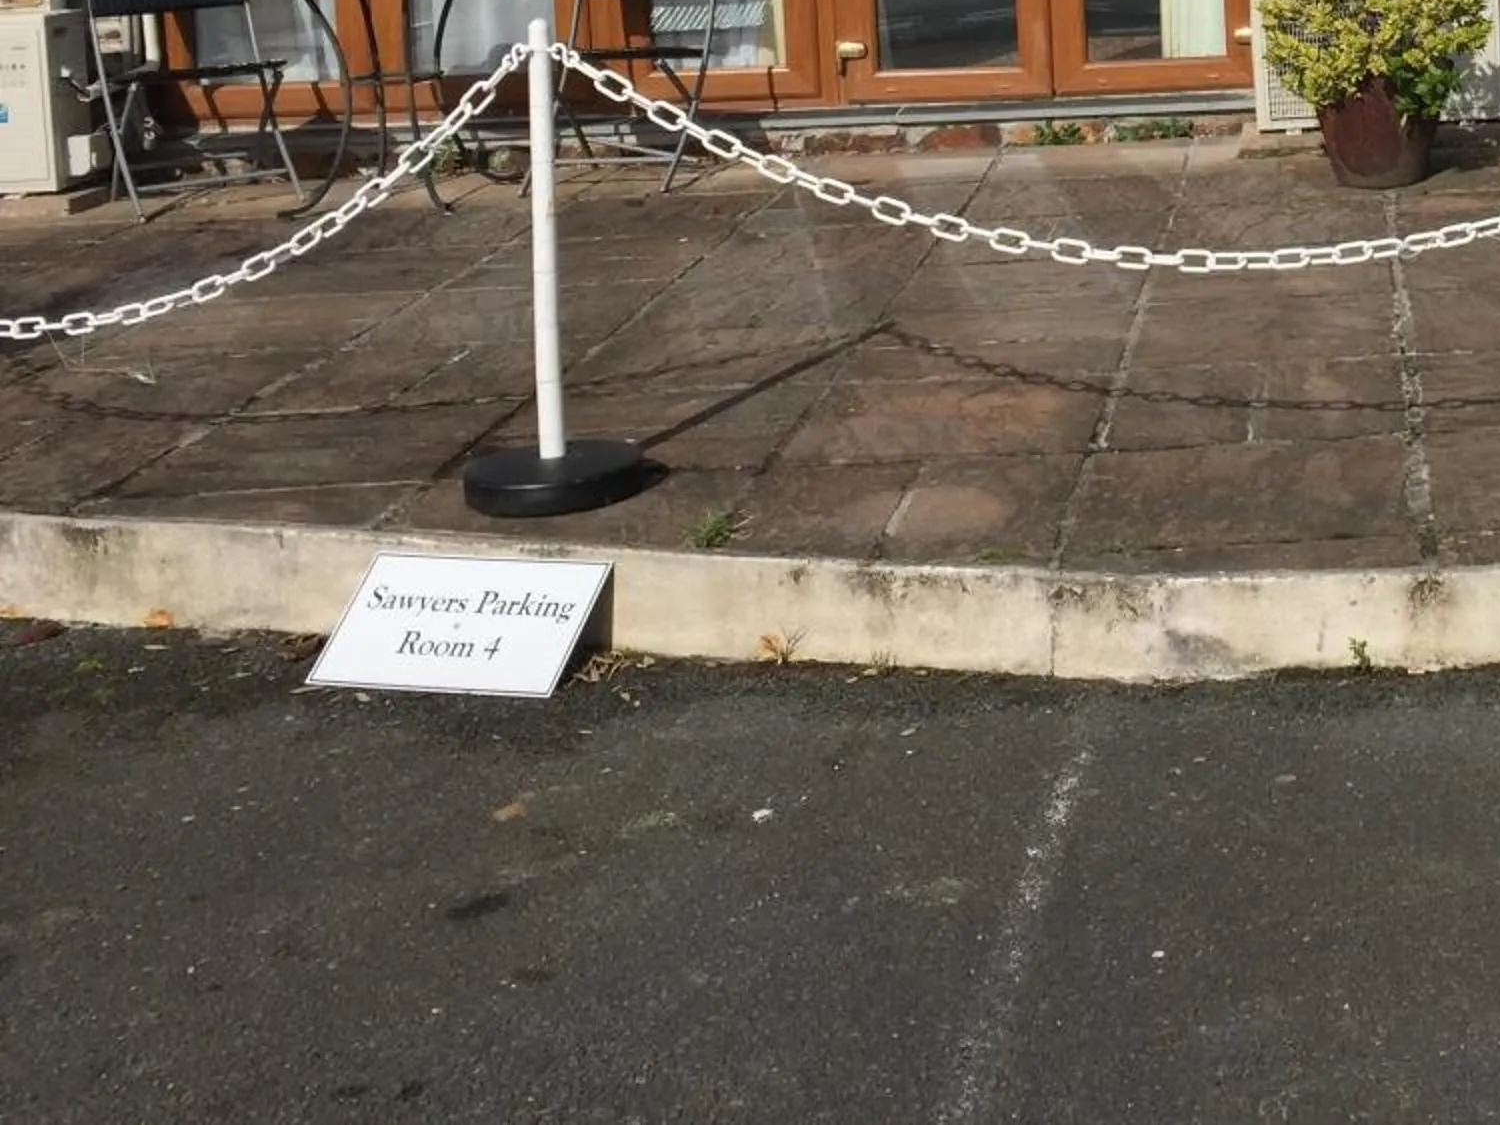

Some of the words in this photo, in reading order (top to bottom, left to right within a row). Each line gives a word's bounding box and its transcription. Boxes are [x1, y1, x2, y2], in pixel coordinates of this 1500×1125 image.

[366, 584, 468, 617] Sawyers
[472, 589, 577, 625] Parking
[395, 630, 475, 659] Room
[483, 635, 502, 661] 4
